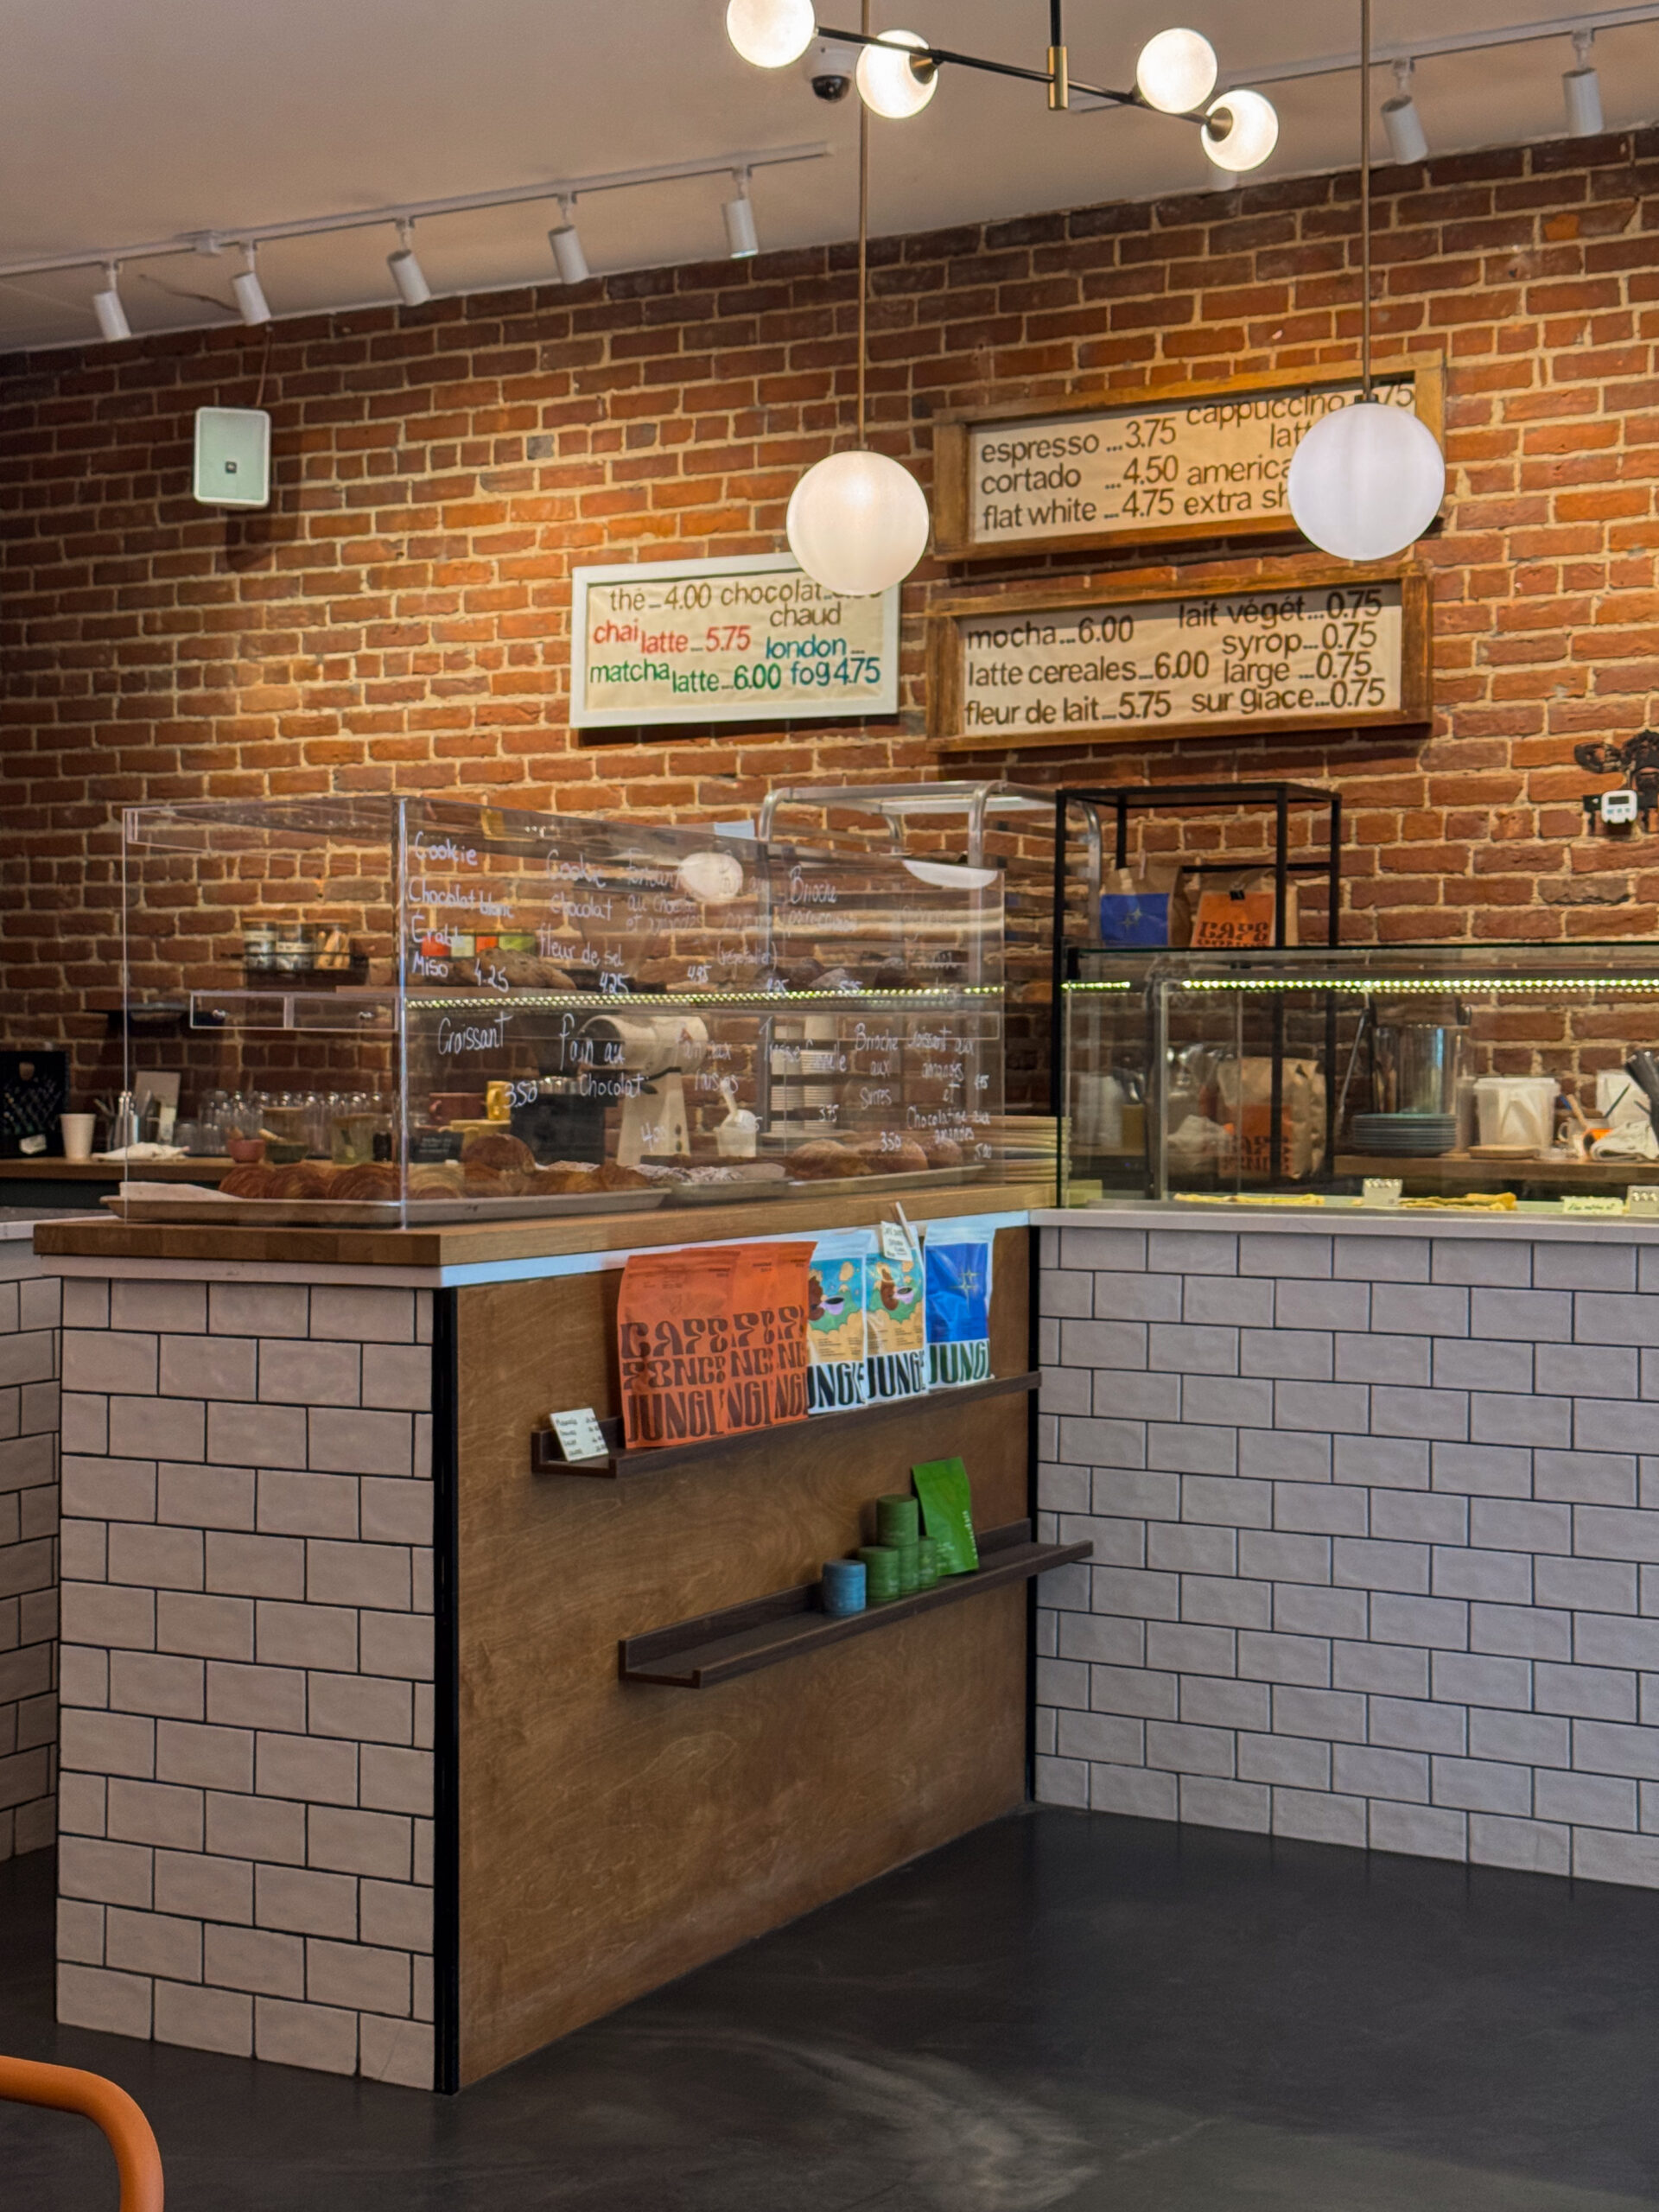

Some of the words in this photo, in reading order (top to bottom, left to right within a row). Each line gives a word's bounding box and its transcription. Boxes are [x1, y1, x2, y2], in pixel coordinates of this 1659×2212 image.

[1186, 391, 1345, 430] cappuccino
[982, 434, 1099, 468] espresso
[982, 462, 1081, 495] cortado
[1187, 454, 1292, 486] america
[983, 503, 1022, 531] flat
[1028, 498, 1097, 526] white
[1184, 489, 1252, 516] extra
[721, 578, 822, 606] chocolat
[770, 601, 842, 627] chaud
[1179, 602, 1218, 629] lait
[594, 619, 639, 645] chai
[640, 631, 689, 654] latte
[766, 634, 847, 659] london
[967, 620, 1057, 649] mocha
[1223, 632, 1302, 661] syrop
[590, 658, 670, 683] matcha
[672, 670, 720, 693] latte
[791, 661, 830, 686] fog
[968, 661, 1023, 686] latte
[1028, 656, 1136, 684] cereales
[1224, 659, 1290, 690] large
[964, 700, 1020, 726] fleur
[1025, 698, 1057, 724] de
[1063, 696, 1099, 722] lait
[1192, 692, 1234, 713] sur
[415, 831, 478, 865] Cookie
[409, 876, 475, 908] Chocolat
[582, 941, 601, 967] de
[437, 1011, 513, 1055] Croissant
[854, 1022, 899, 1052] Brioche
[580, 1073, 646, 1098] Chocolat
